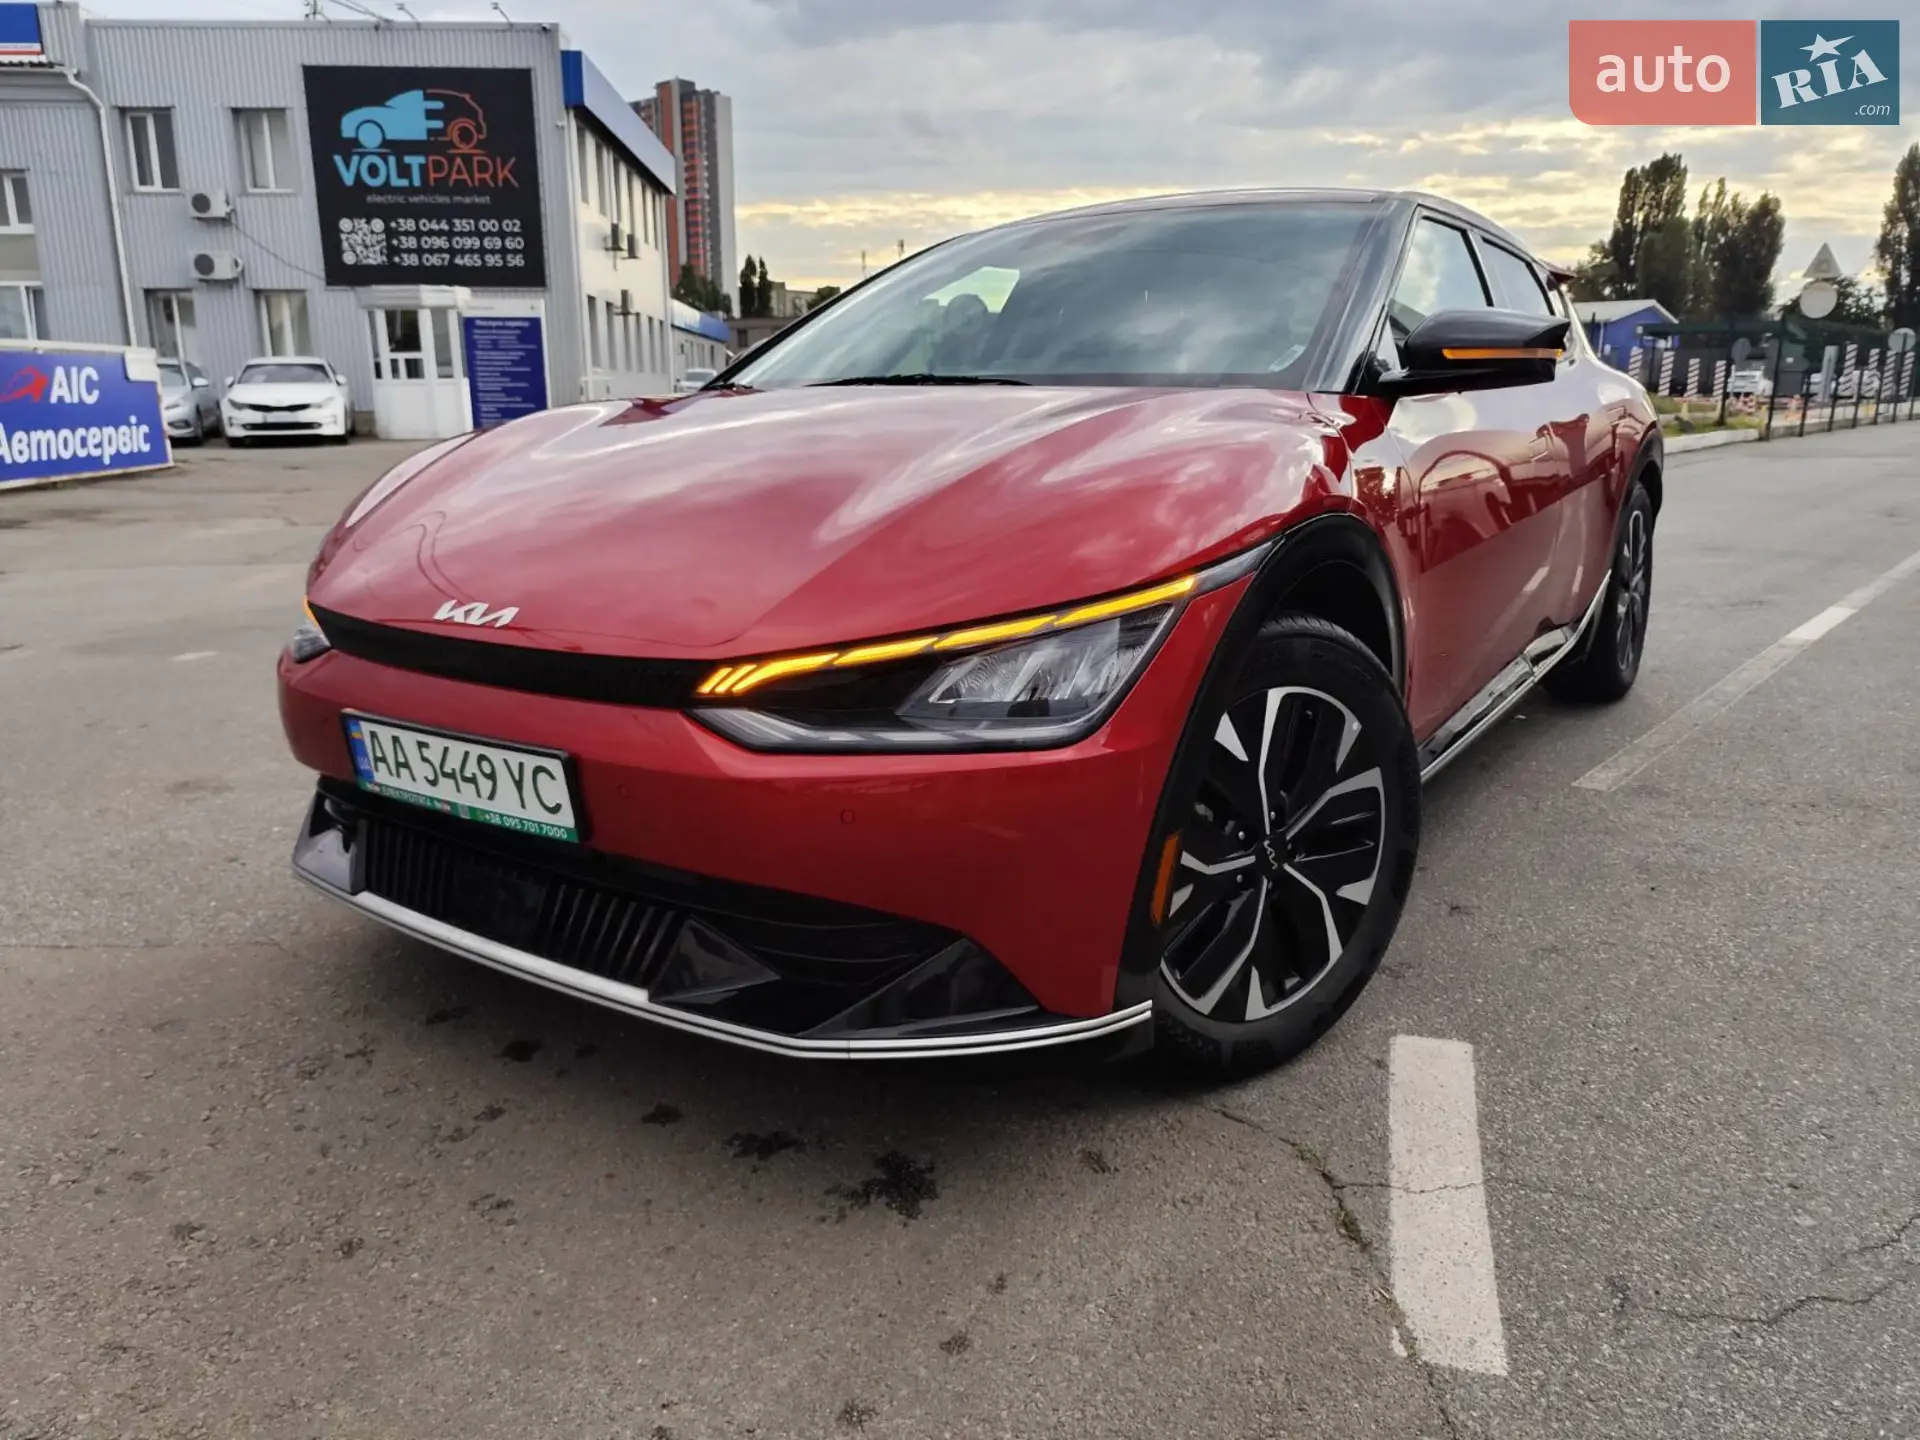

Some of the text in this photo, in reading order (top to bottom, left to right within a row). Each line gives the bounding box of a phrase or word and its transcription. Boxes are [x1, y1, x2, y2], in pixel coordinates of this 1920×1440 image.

[366, 194, 491, 205] electric vehicles market
[389, 218, 522, 232] +38 044 351 00 02
[391, 236, 525, 250] +38 096 099 69 60
[393, 253, 525, 267] +38 067 465 95 56
[433, 599, 519, 628] KIA
